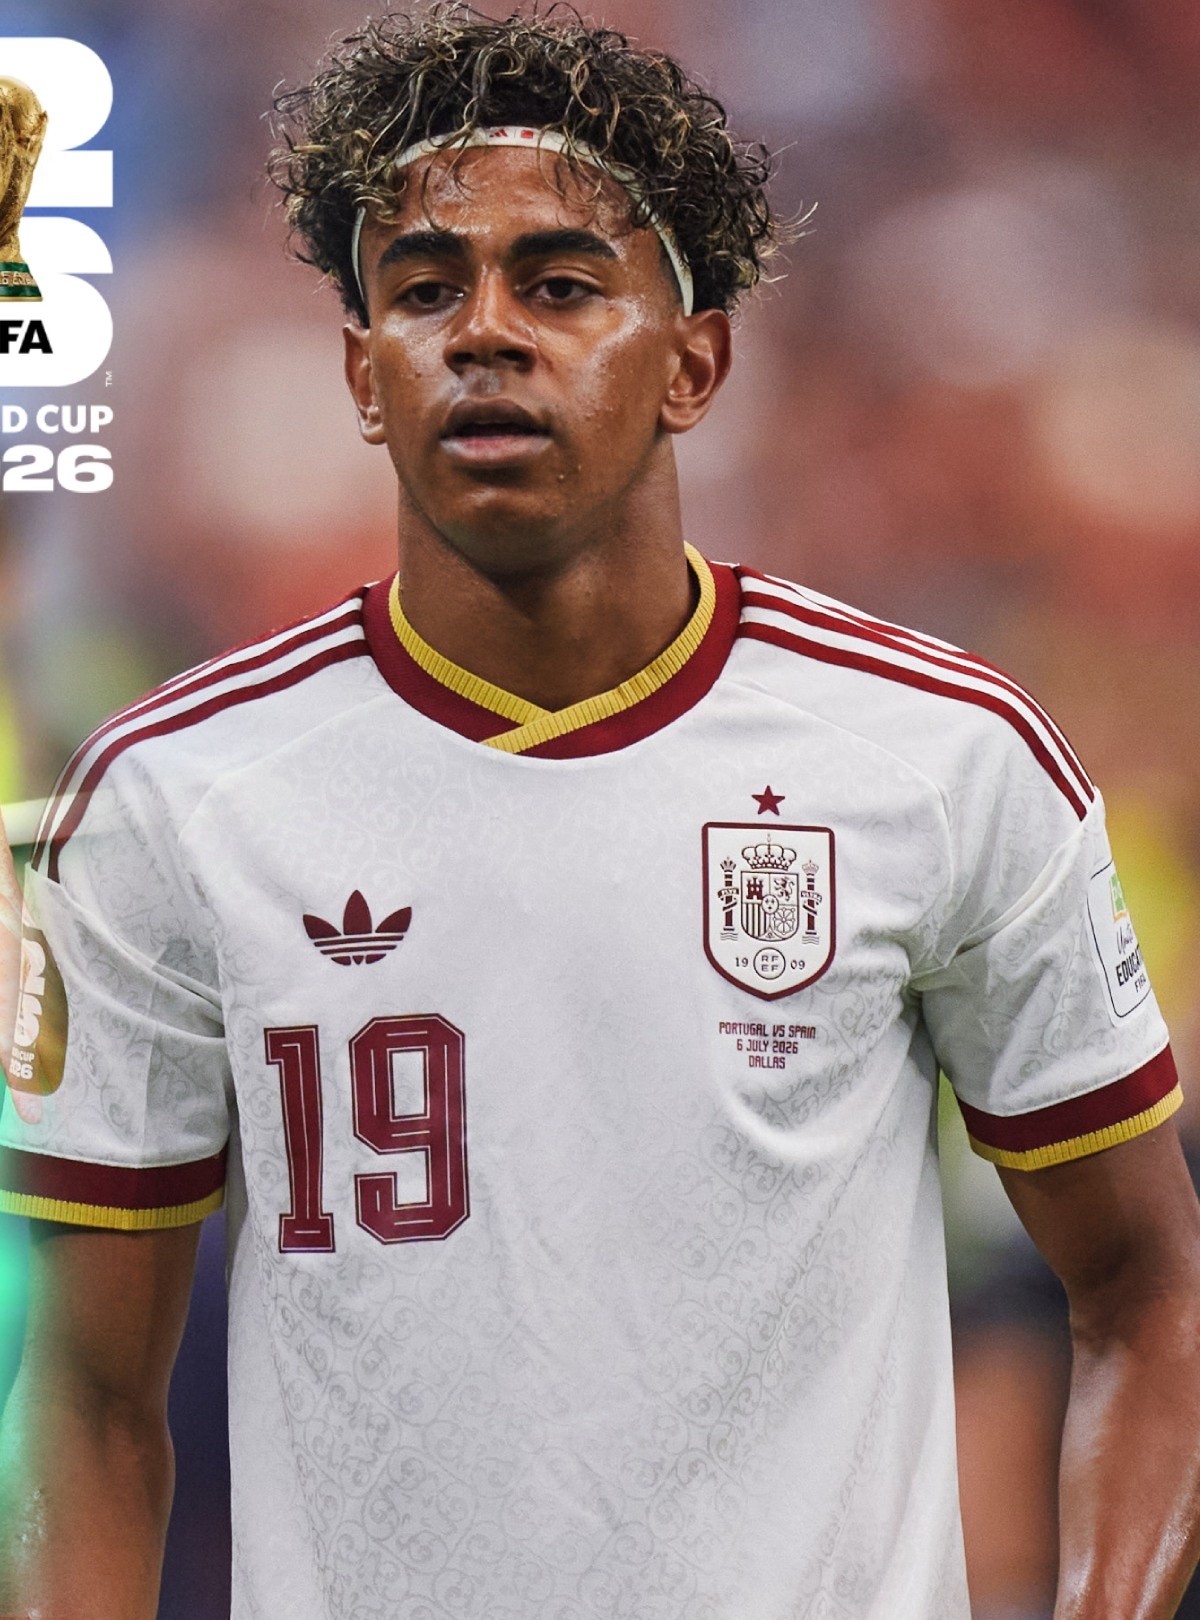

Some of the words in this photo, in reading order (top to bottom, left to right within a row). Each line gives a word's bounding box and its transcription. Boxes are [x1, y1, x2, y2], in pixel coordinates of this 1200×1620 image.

[735, 957, 749, 967] 19
[790, 960, 806, 970] 09
[719, 1021, 769, 1037] PORTUGAL
[772, 1024, 786, 1038] VS
[788, 1025, 817, 1039] SPAIN
[736, 1038, 743, 1051] 6
[746, 1039, 769, 1052] JULY
[772, 1040, 799, 1054] 2026
[748, 1055, 786, 1069] DALLAS
[264, 1013, 471, 1253] 19
